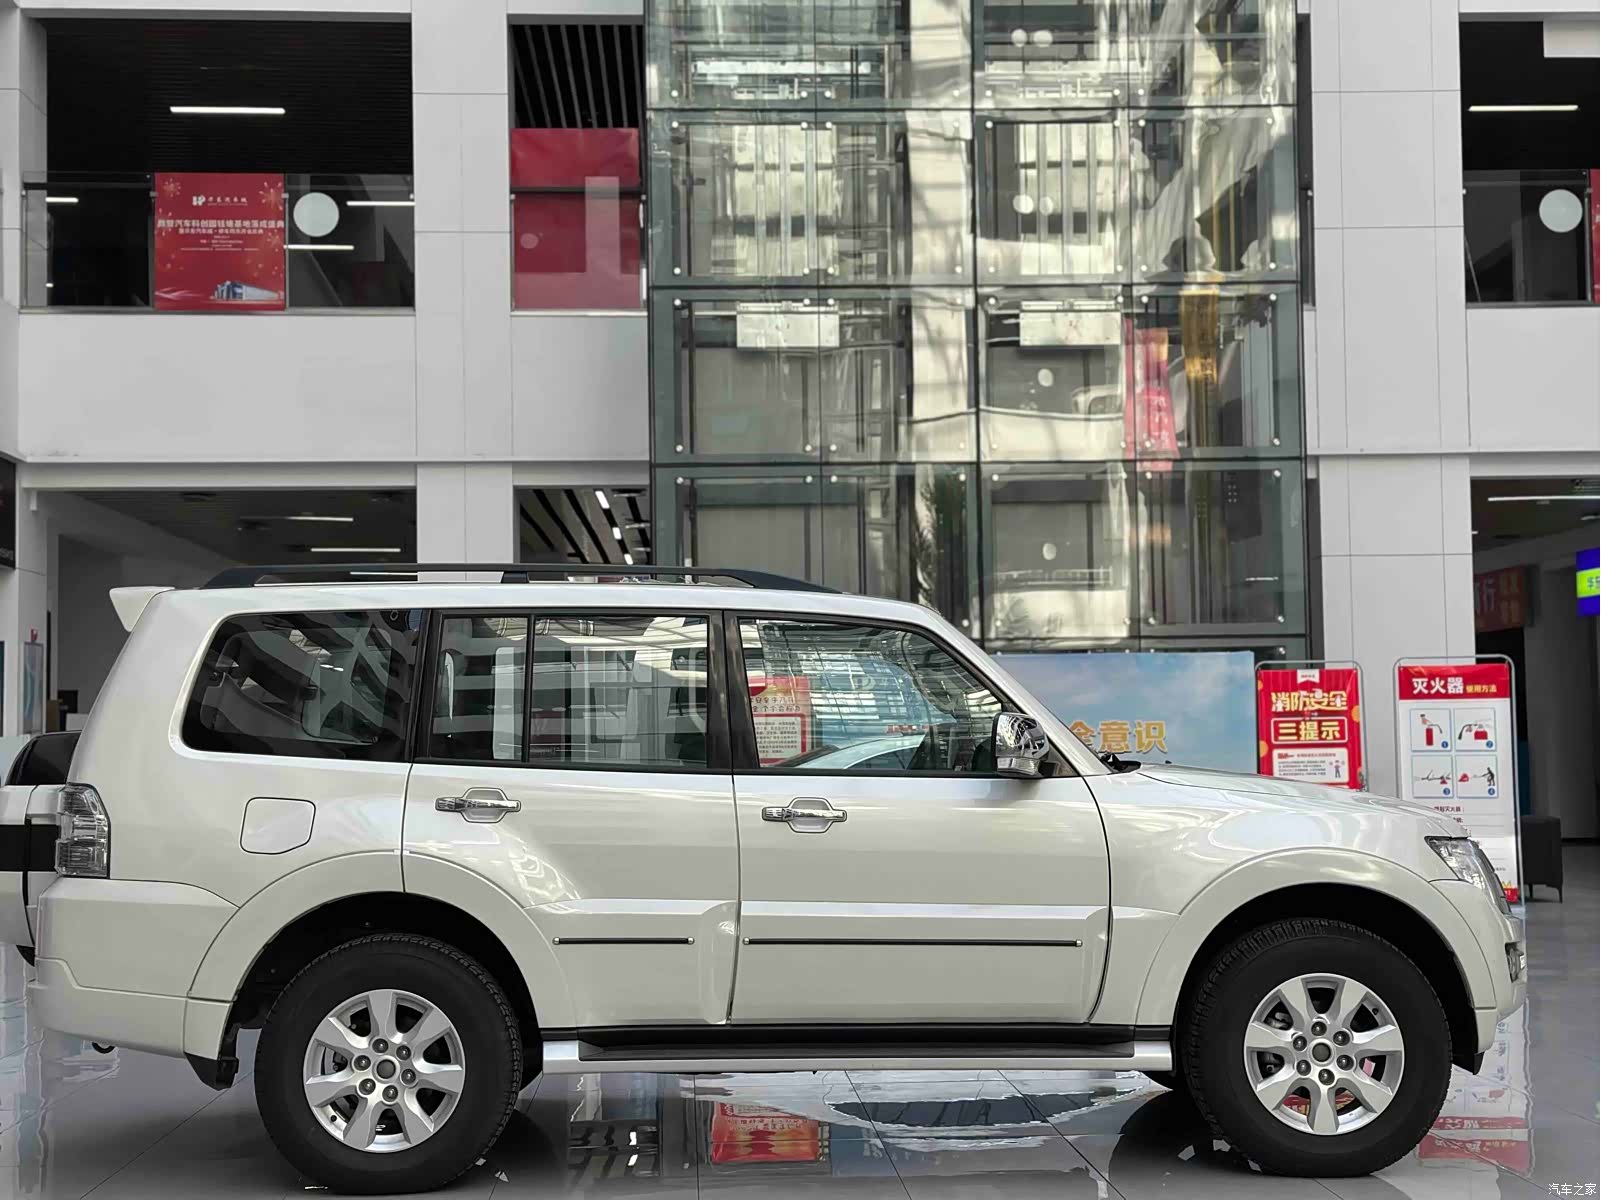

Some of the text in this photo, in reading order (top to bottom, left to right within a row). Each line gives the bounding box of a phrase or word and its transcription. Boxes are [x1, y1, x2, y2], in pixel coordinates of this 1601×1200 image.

[1412, 677, 1464, 695] 灭火器
[1466, 684, 1497, 694] 使用方法
[1270, 689, 1348, 712] 消防安全
[1278, 721, 1341, 741] 三提示
